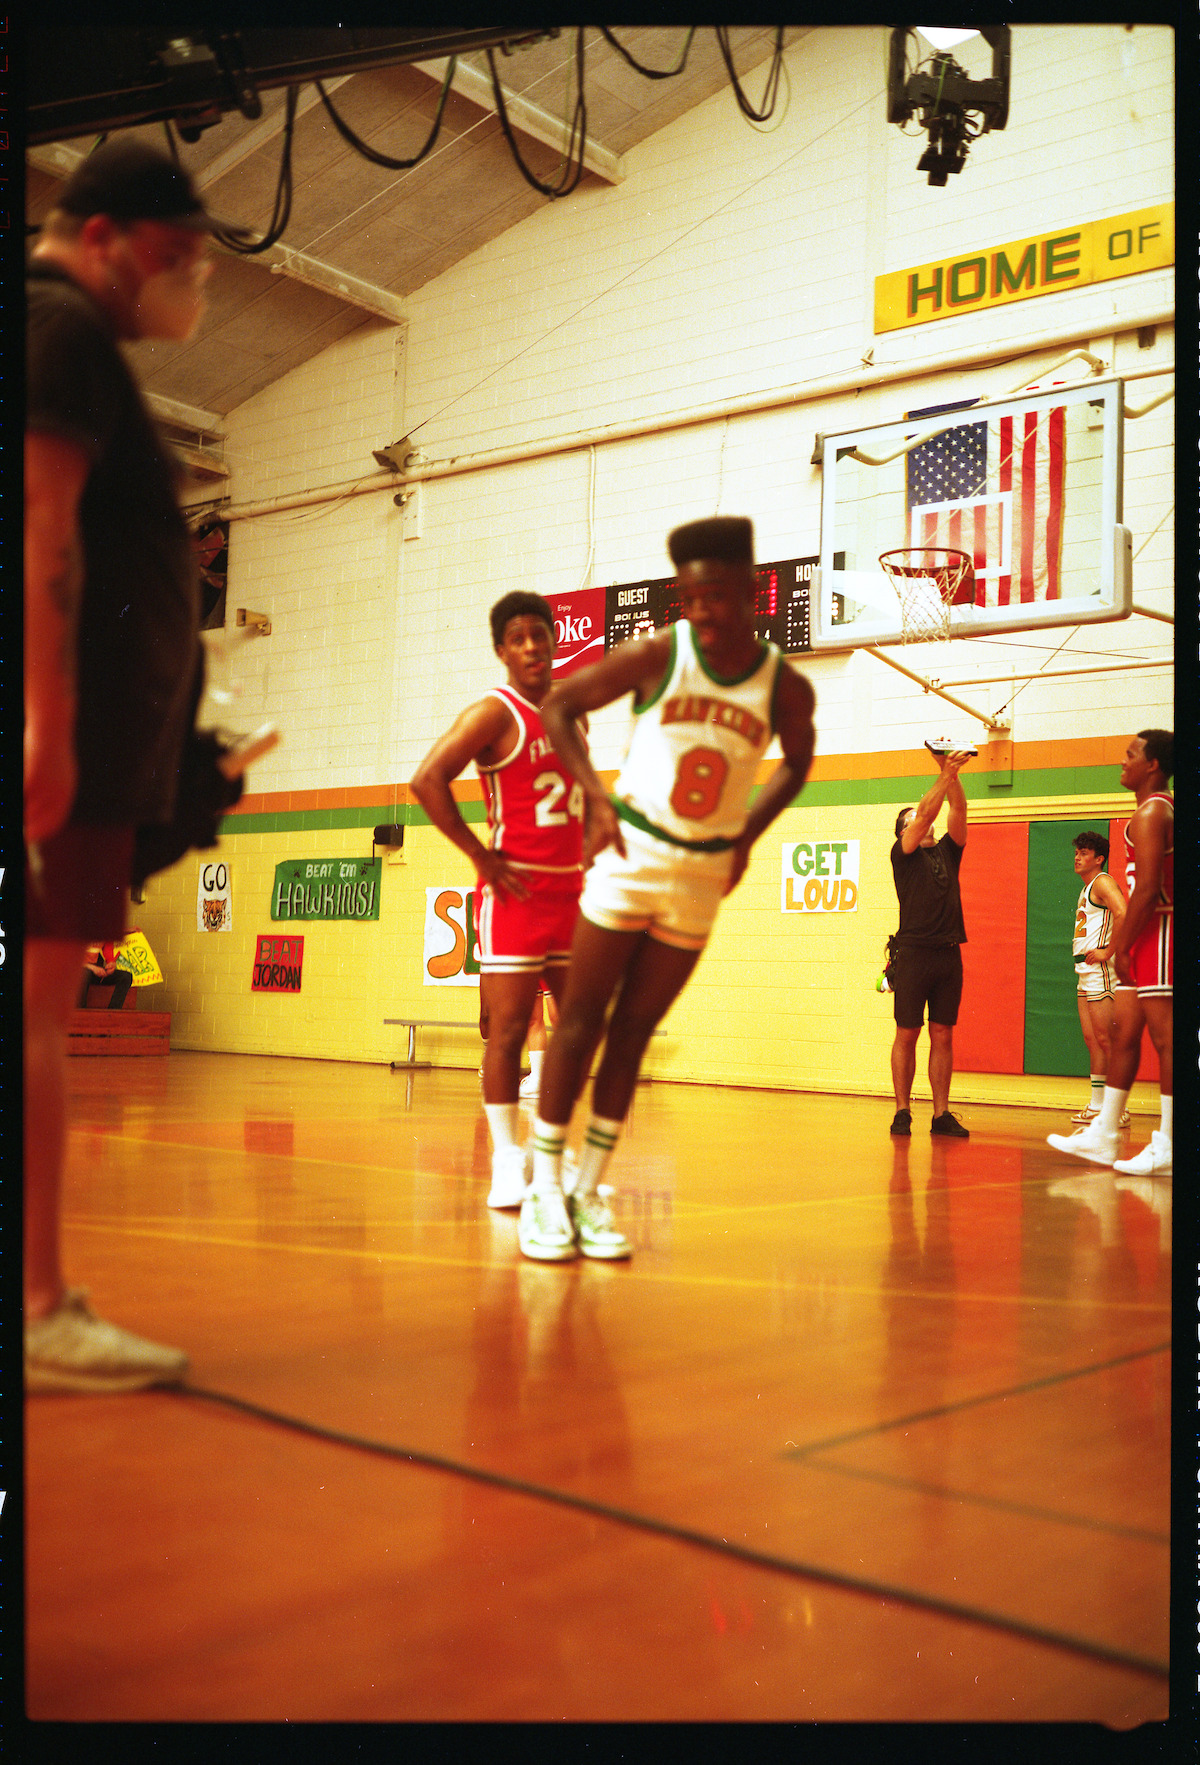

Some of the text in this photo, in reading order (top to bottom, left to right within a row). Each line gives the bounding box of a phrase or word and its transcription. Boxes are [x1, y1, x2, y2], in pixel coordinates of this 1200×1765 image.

[907, 222, 1160, 318] HOME OF
[557, 604, 572, 612] Enjoy
[617, 587, 649, 607] GUEST
[553, 615, 592, 644] oke
[614, 610, 650, 622] BONUS
[669, 745, 730, 821] 8
[532, 770, 584, 828] 24
[305, 861, 357, 878] BEAT 'EM
[792, 843, 848, 877] GET
[203, 864, 227, 891] GO
[276, 881, 376, 917] HAWKINS!
[785, 877, 857, 911] LOUD
[259, 940, 303, 962] BEAT
[253, 964, 301, 990] JORDAN
